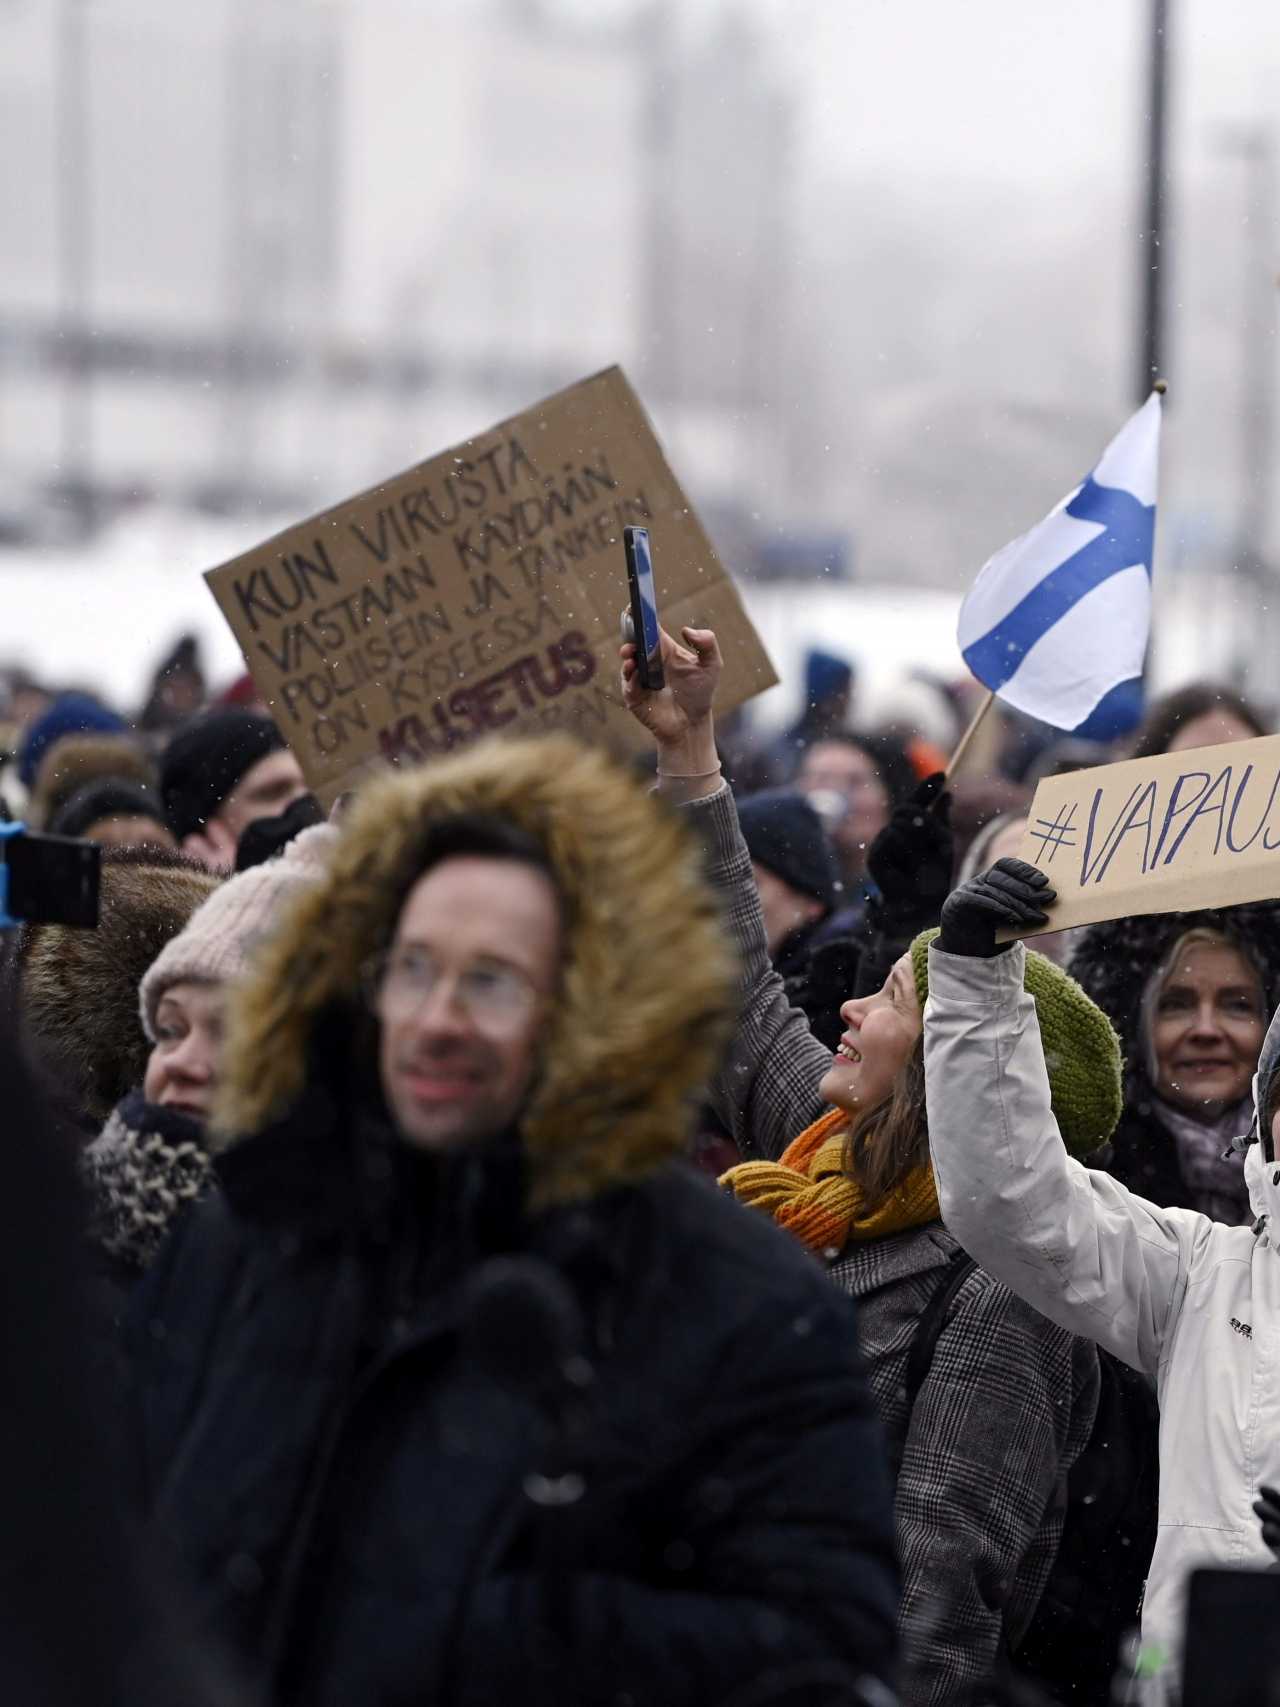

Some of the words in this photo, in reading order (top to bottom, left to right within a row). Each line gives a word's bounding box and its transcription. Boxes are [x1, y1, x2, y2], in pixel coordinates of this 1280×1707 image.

[232, 537, 339, 632] KUN
[350, 437, 539, 562] VIRUSTA
[257, 553, 437, 673] VASTAAN
[281, 602, 454, 722] POLIISEIN
[464, 571, 512, 618] JA
[507, 488, 653, 600] TANKEIN
[312, 699, 371, 752] ON
[377, 630, 597, 768] KUSETUS
